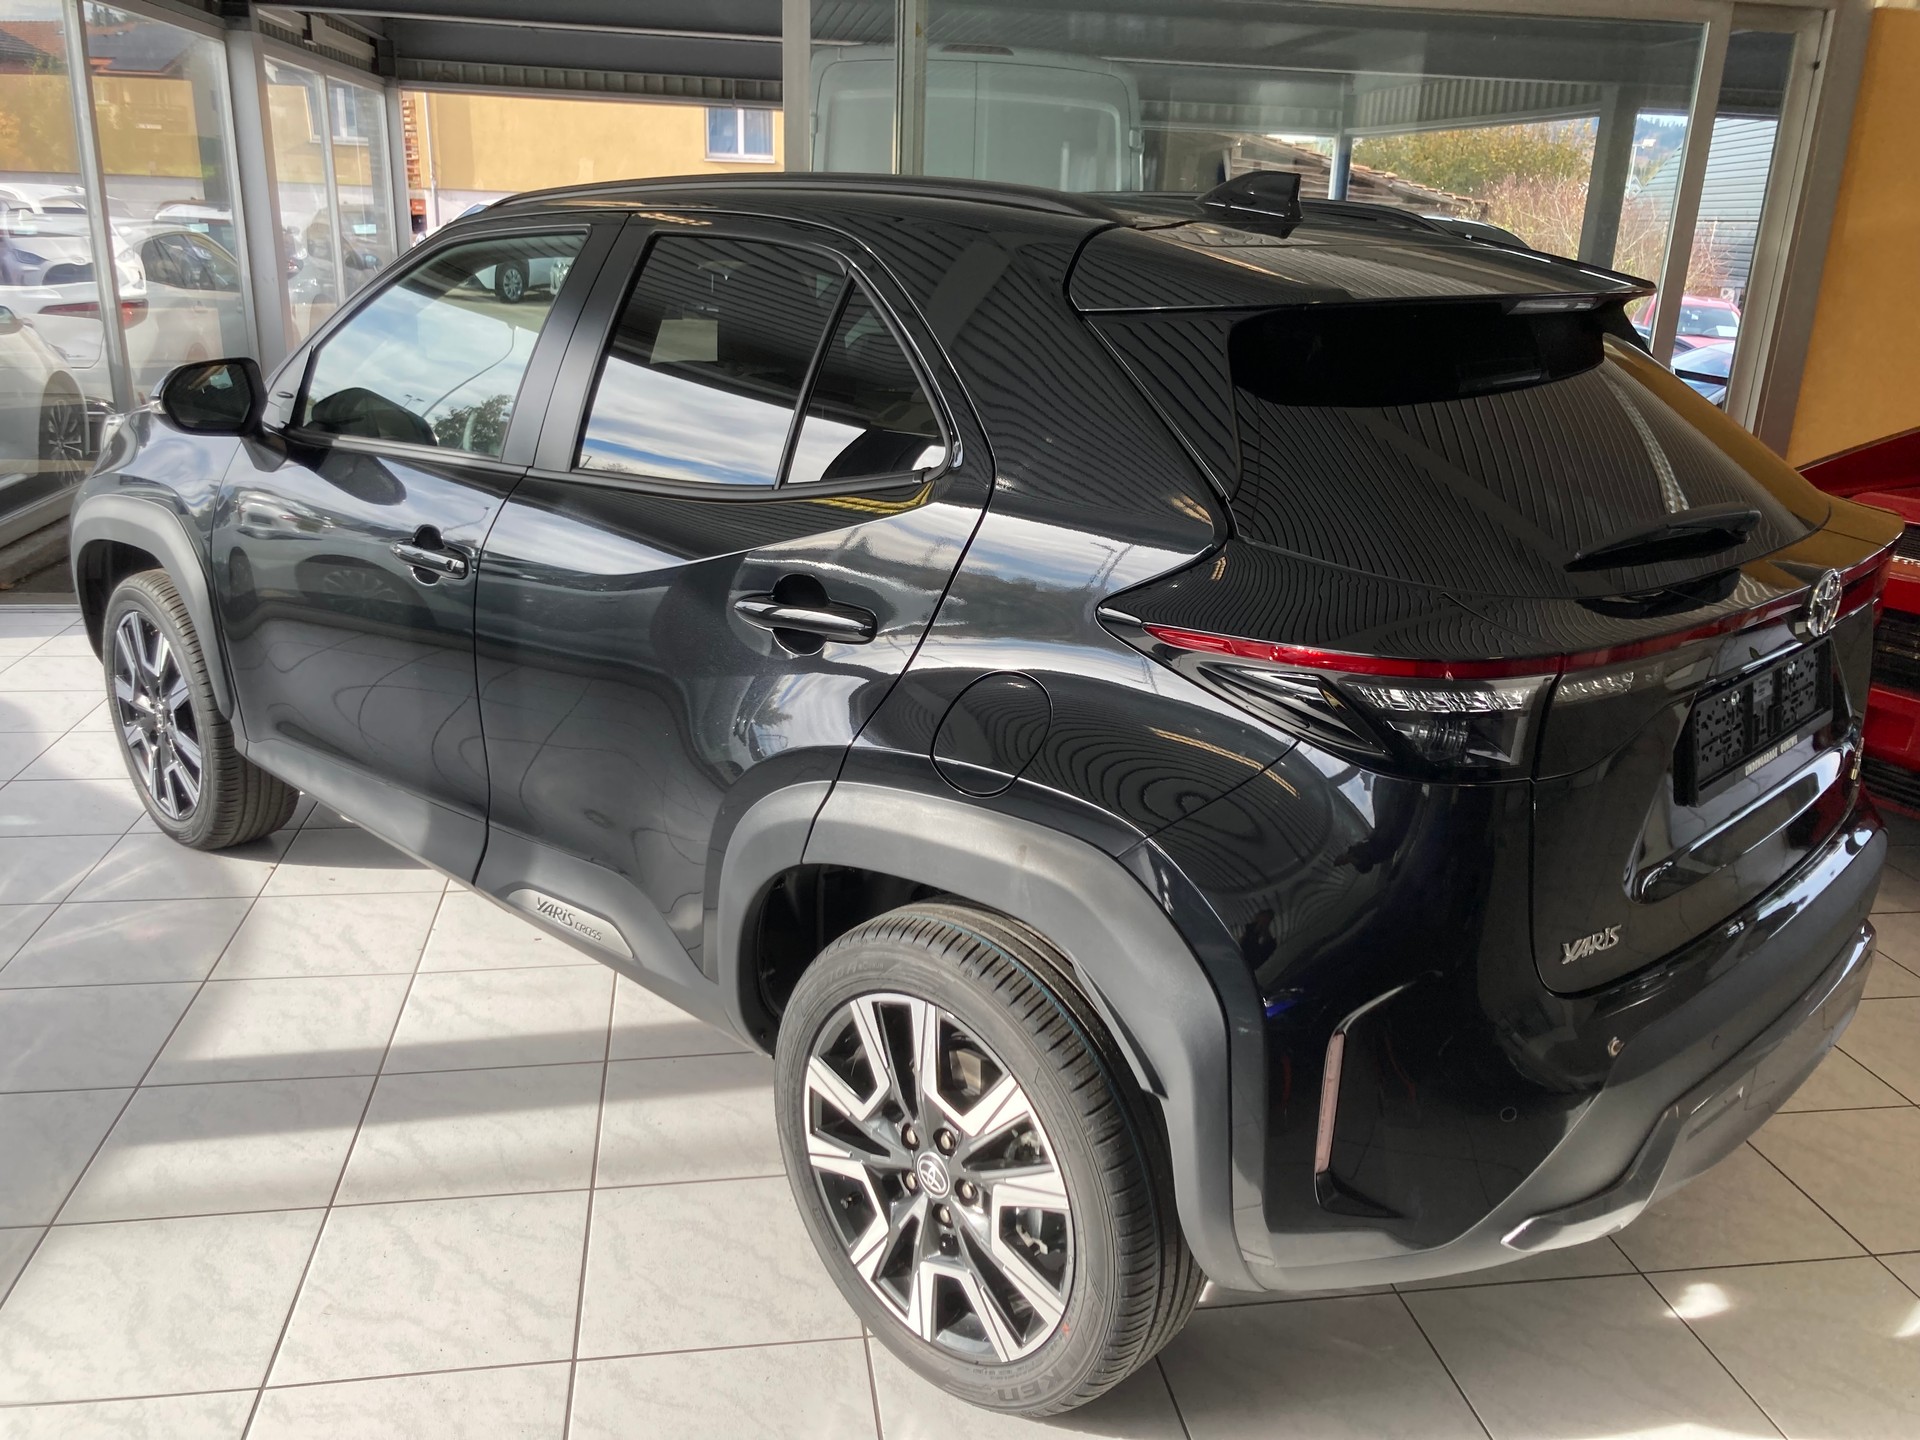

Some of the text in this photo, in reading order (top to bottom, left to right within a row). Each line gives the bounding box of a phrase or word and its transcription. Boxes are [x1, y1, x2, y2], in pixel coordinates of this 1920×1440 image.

[537, 896, 602, 941] YARIS CROSS
[1562, 924, 1622, 965] YARIS
